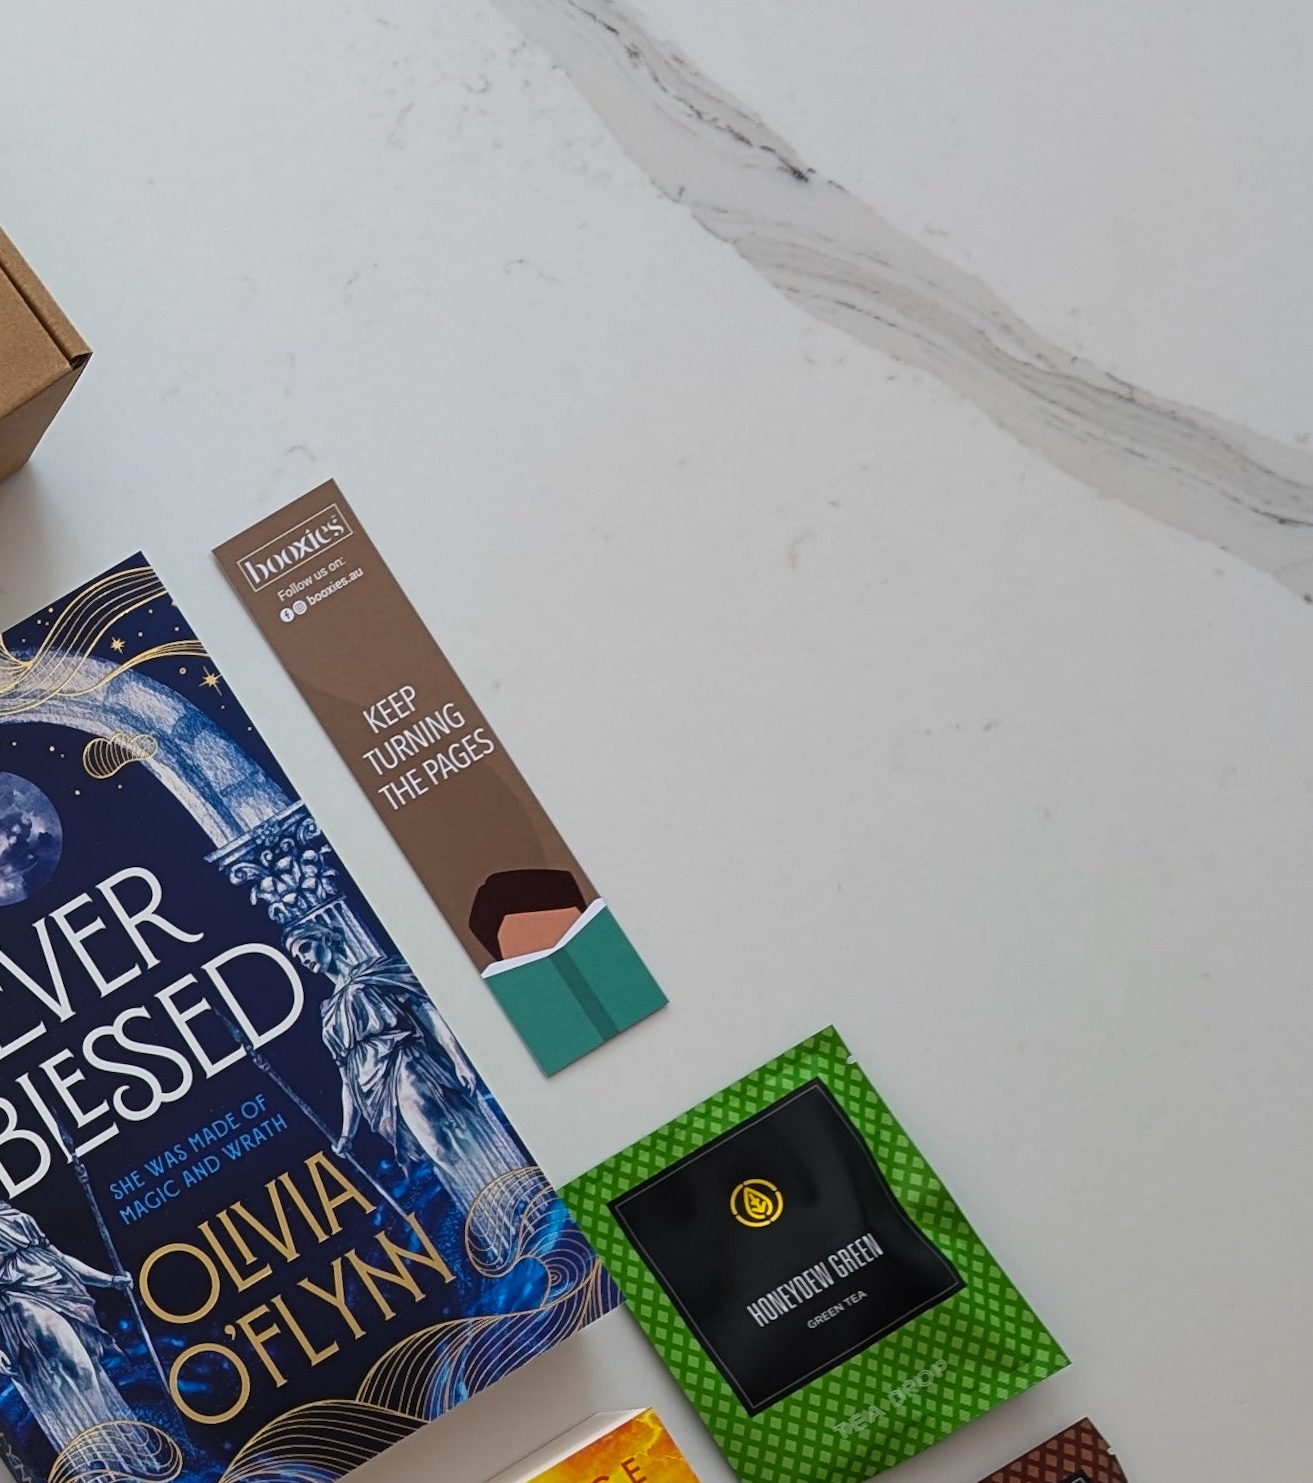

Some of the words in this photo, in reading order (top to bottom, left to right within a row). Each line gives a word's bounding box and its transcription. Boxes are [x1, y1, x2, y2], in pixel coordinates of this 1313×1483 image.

[361, 684, 416, 734] KEEP
[361, 701, 466, 776] TURNING
[377, 767, 430, 810] THE
[421, 727, 495, 786] PAGES
[109, 1169, 146, 1200] SHE
[143, 1143, 188, 1177] WAS
[187, 1111, 241, 1153] MADE
[240, 1092, 267, 1120] OF
[118, 1178, 181, 1225] MAGIC
[181, 1154, 221, 1188] AND
[220, 1112, 288, 1161] WRATH
[138, 1149, 378, 1324] OLIVIA
[745, 1260, 835, 1328] HONEYDEW
[827, 1231, 884, 1278] GREEN
[152, 1210, 457, 1425] O'FLYNN
[806, 1302, 845, 1329] GREEN
[842, 1289, 868, 1306] TEA
